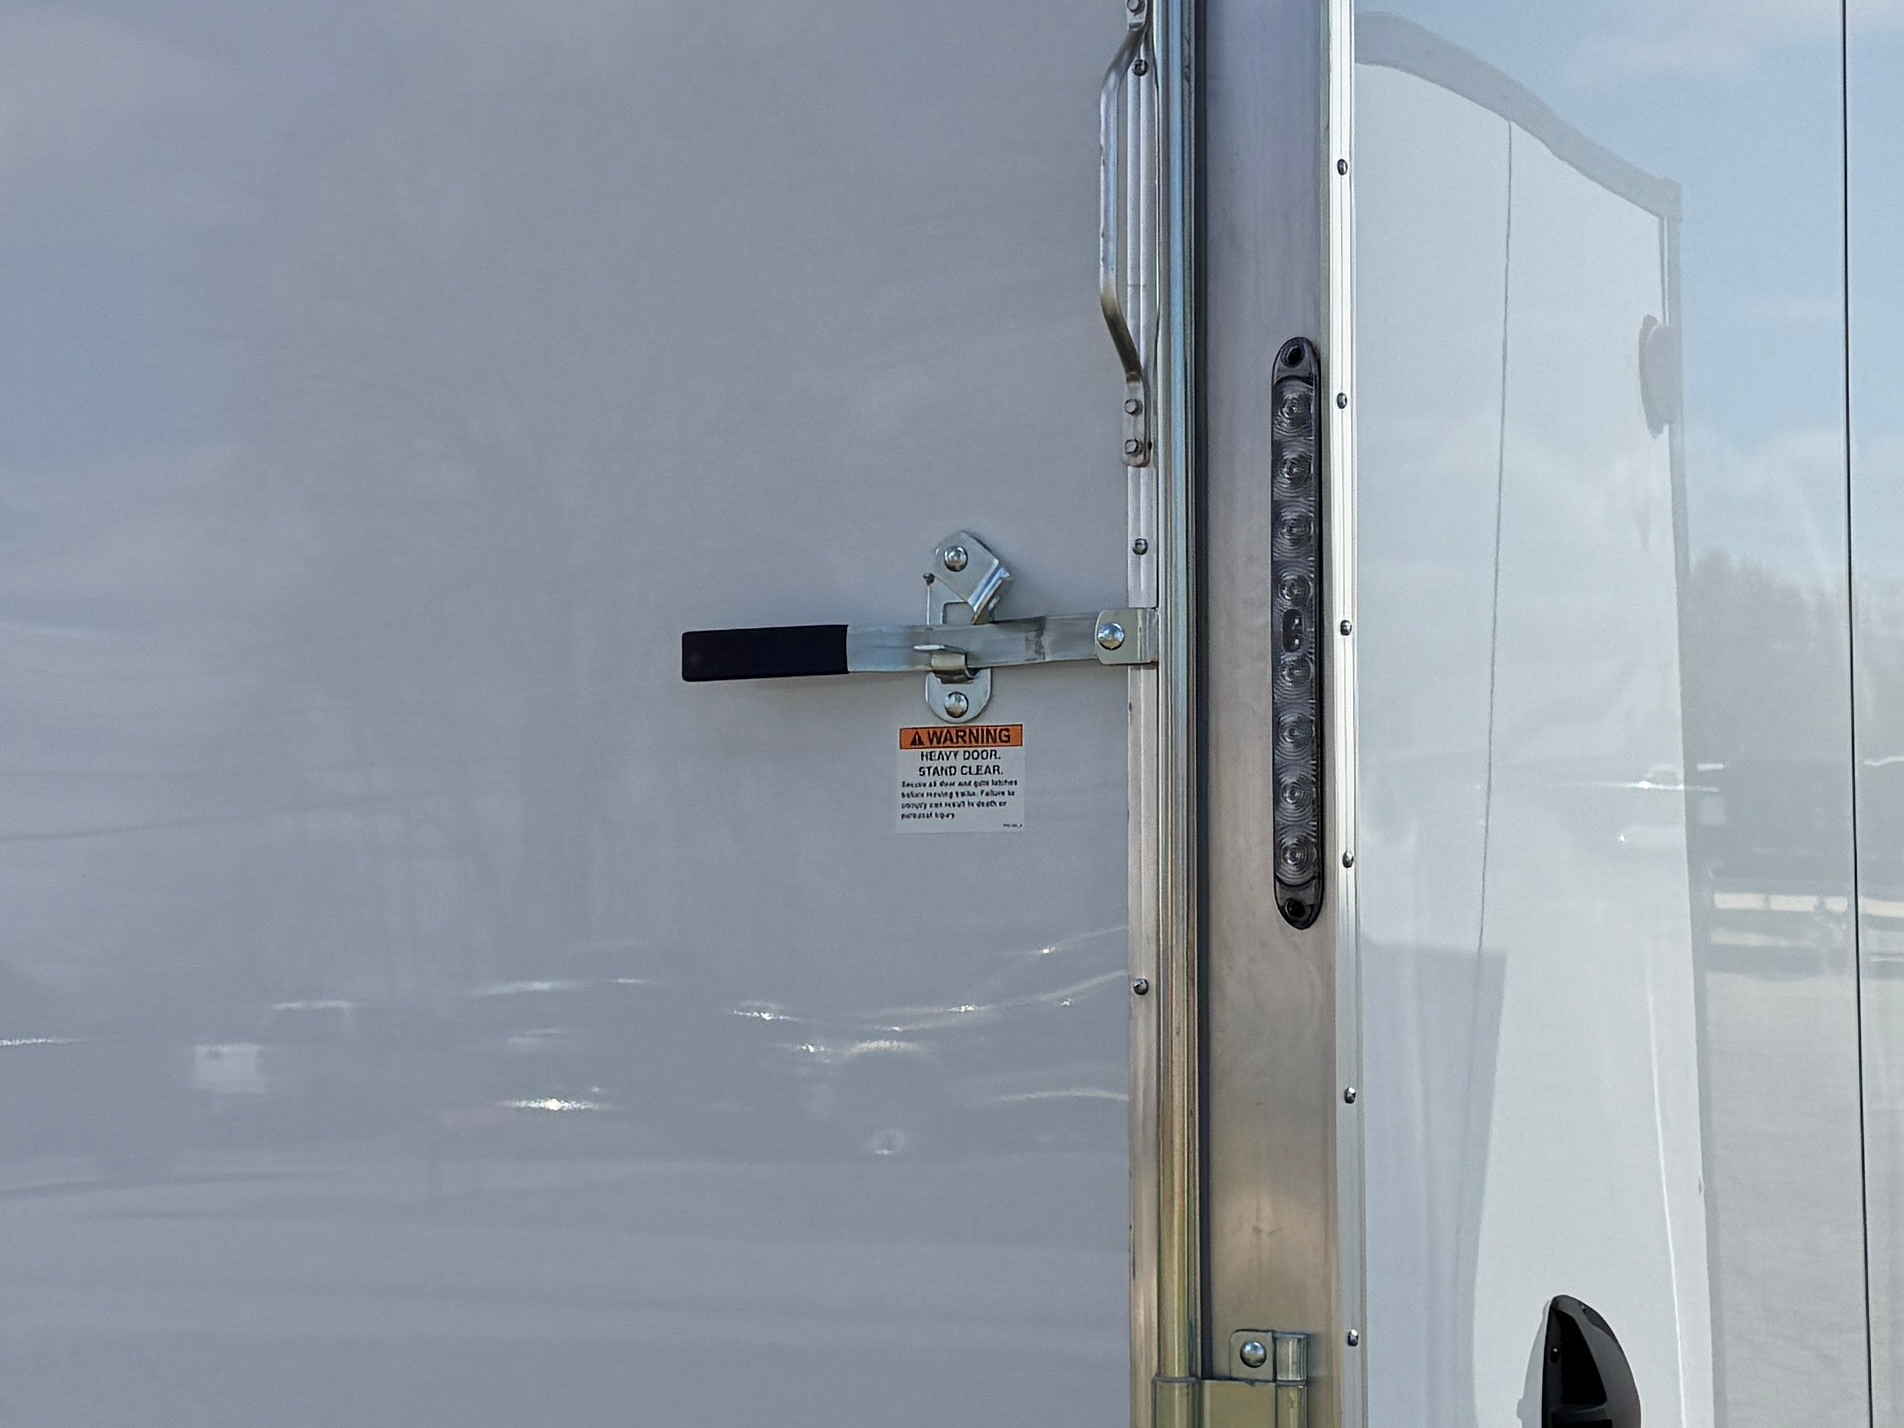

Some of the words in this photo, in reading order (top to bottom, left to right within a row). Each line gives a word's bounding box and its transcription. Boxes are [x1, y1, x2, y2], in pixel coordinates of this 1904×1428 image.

[927, 727, 1011, 745] WARNING
[920, 750, 959, 762] HEAVY
[962, 749, 1001, 761] DOOR.
[918, 765, 957, 777] STAND
[960, 764, 1004, 776] CLEAR.
